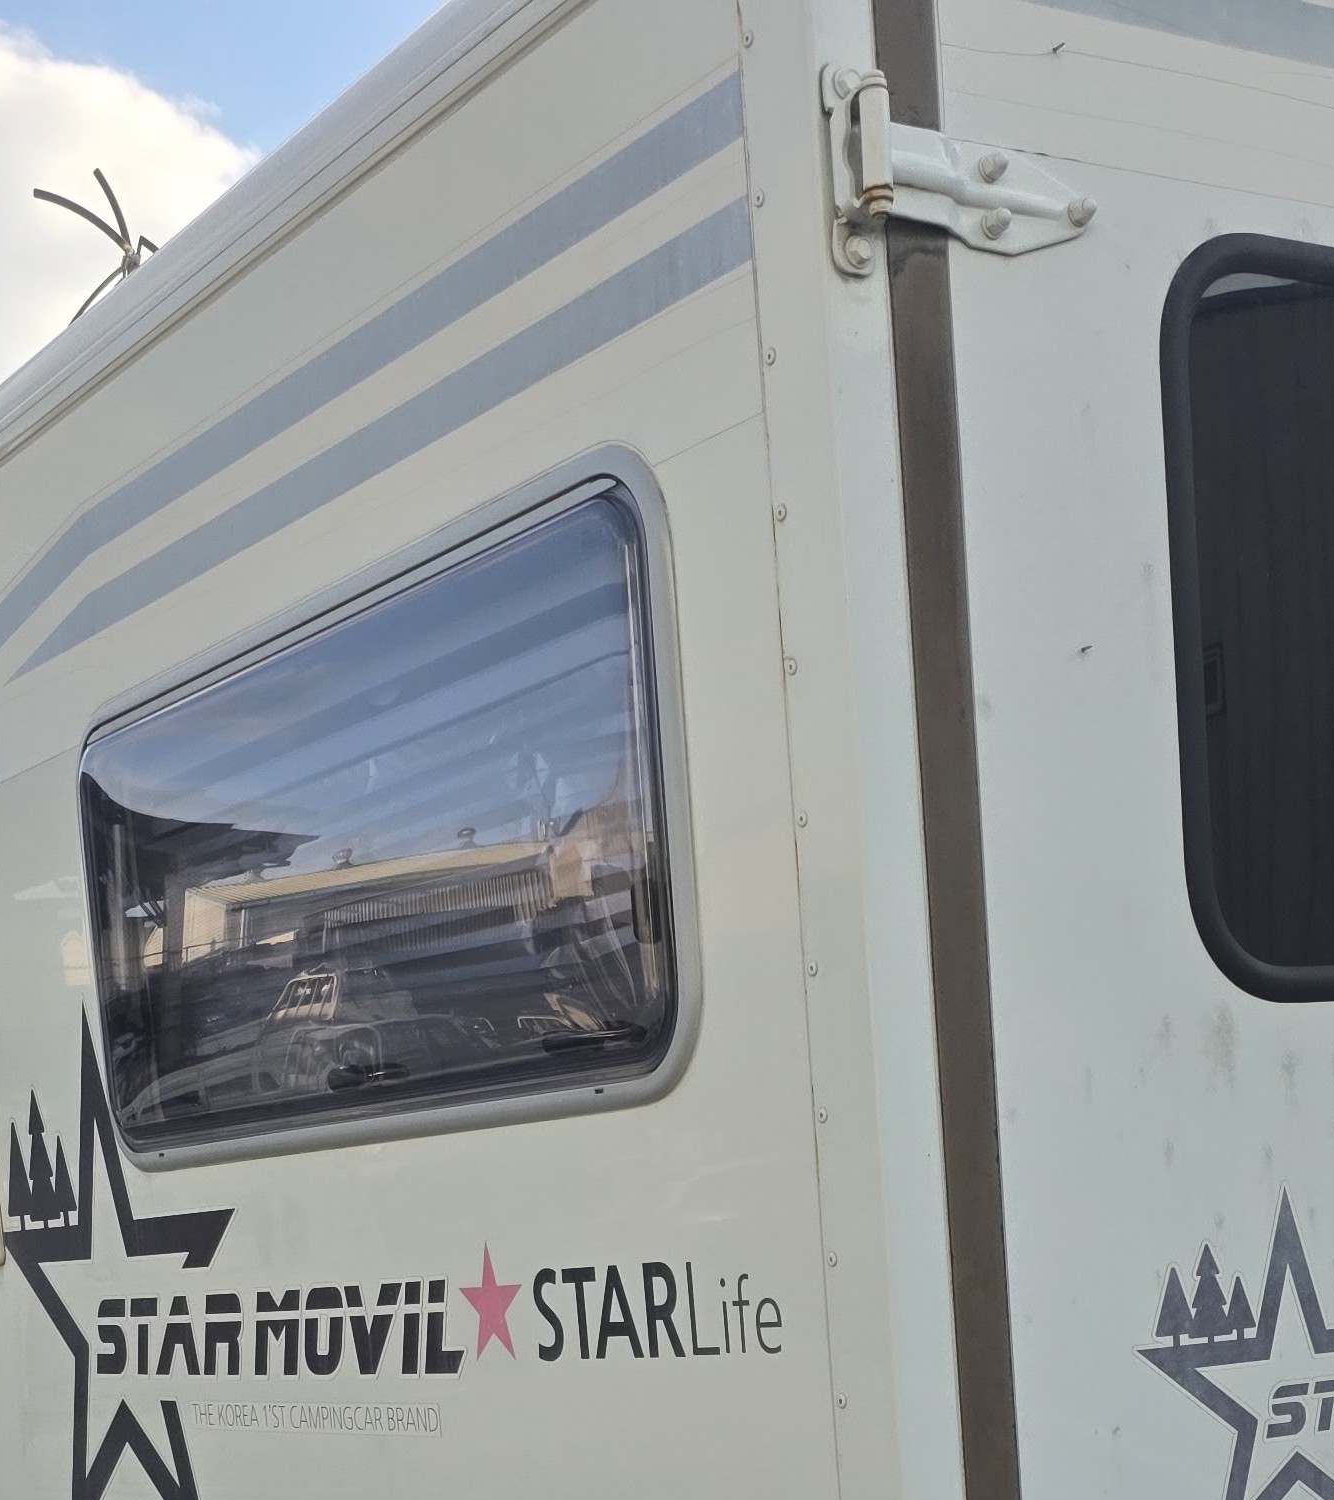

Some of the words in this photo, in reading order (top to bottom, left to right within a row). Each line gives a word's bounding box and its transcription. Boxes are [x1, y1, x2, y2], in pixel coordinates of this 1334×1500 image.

[96, 1294, 242, 1376] STAR
[254, 1279, 466, 1376] MOVIL
[533, 1260, 783, 1363] STARLife
[191, 1403, 216, 1426] THE
[218, 1404, 259, 1428] KOREA
[289, 1405, 384, 1432] CAMPINGCAR
[386, 1406, 439, 1433] BRAND
